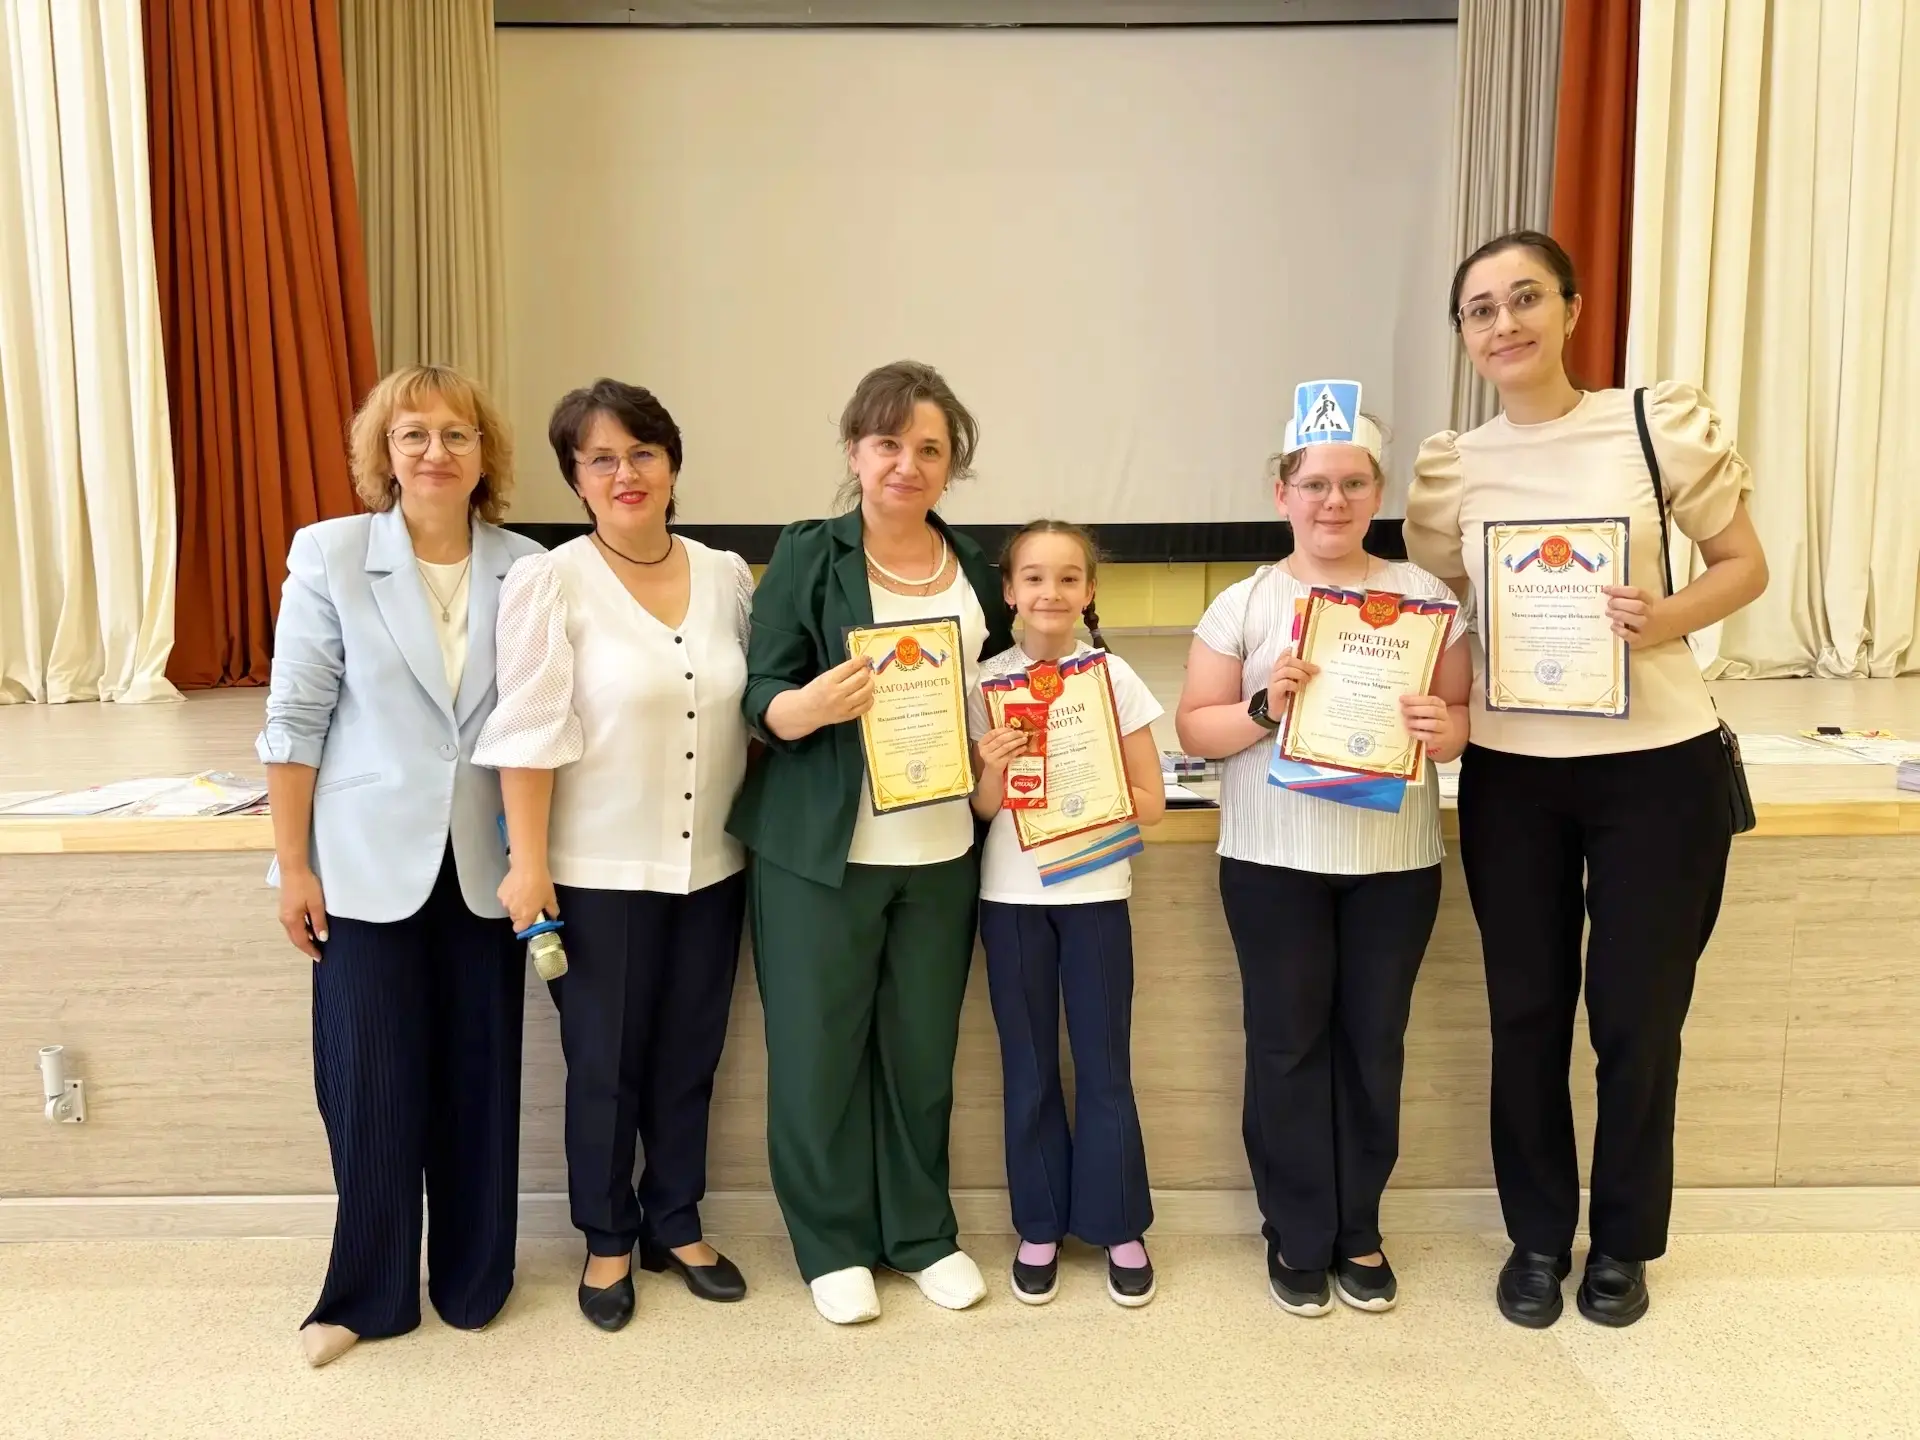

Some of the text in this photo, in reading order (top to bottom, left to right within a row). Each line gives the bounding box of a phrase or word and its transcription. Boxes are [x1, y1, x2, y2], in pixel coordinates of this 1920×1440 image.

[1338, 631, 1410, 649] ПОЧЕТНАЯ
[1342, 643, 1401, 660] ГРАМОТА
[1048, 702, 1086, 720] ЕТНАЯ
